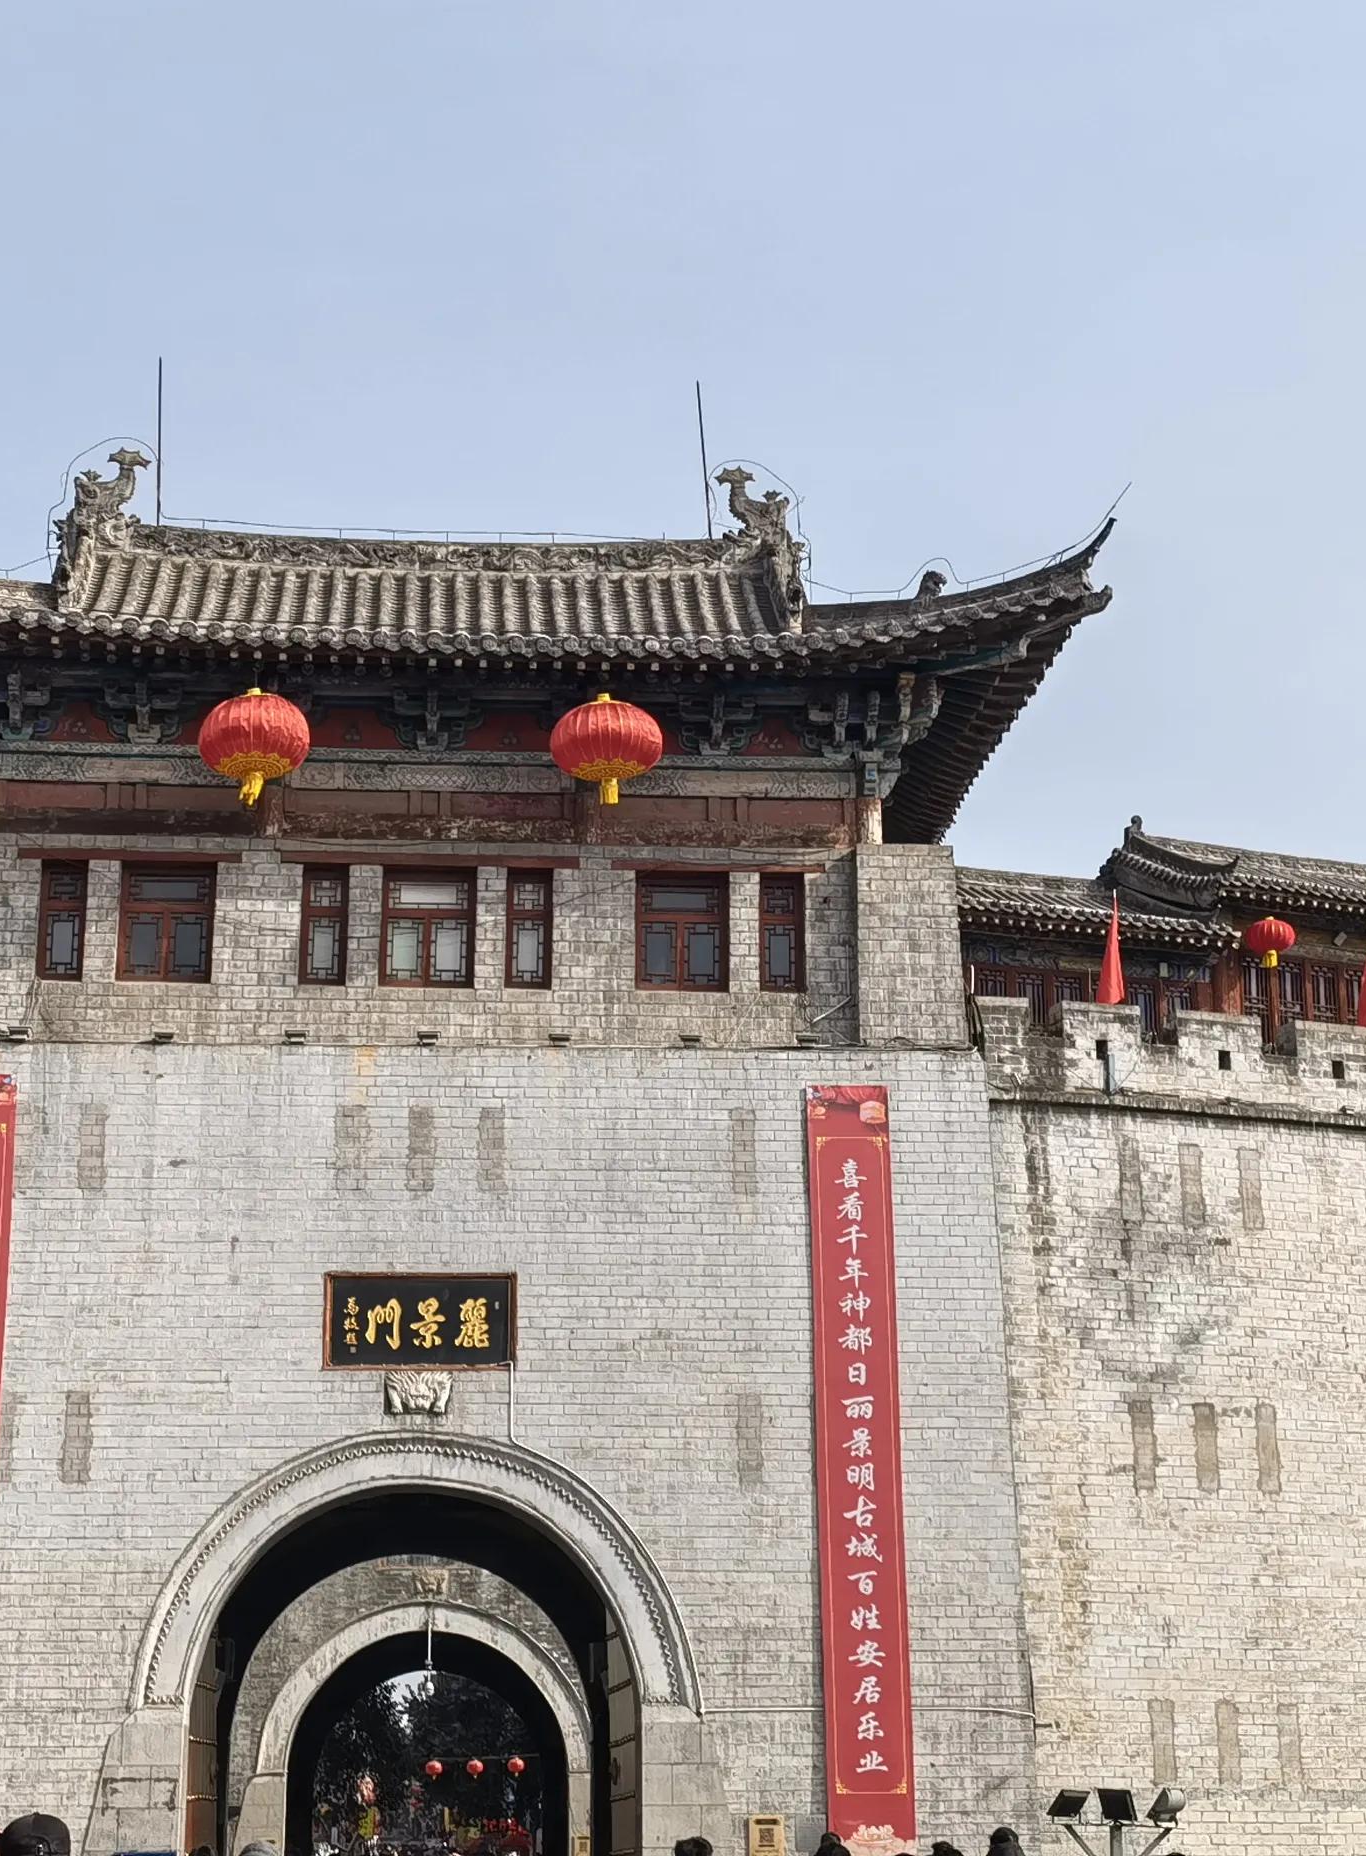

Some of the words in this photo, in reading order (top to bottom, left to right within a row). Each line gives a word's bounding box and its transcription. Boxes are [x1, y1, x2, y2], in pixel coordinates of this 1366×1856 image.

[835, 1158, 888, 1773] 喜看千年神都日丽景明古城百姓安居乐业
